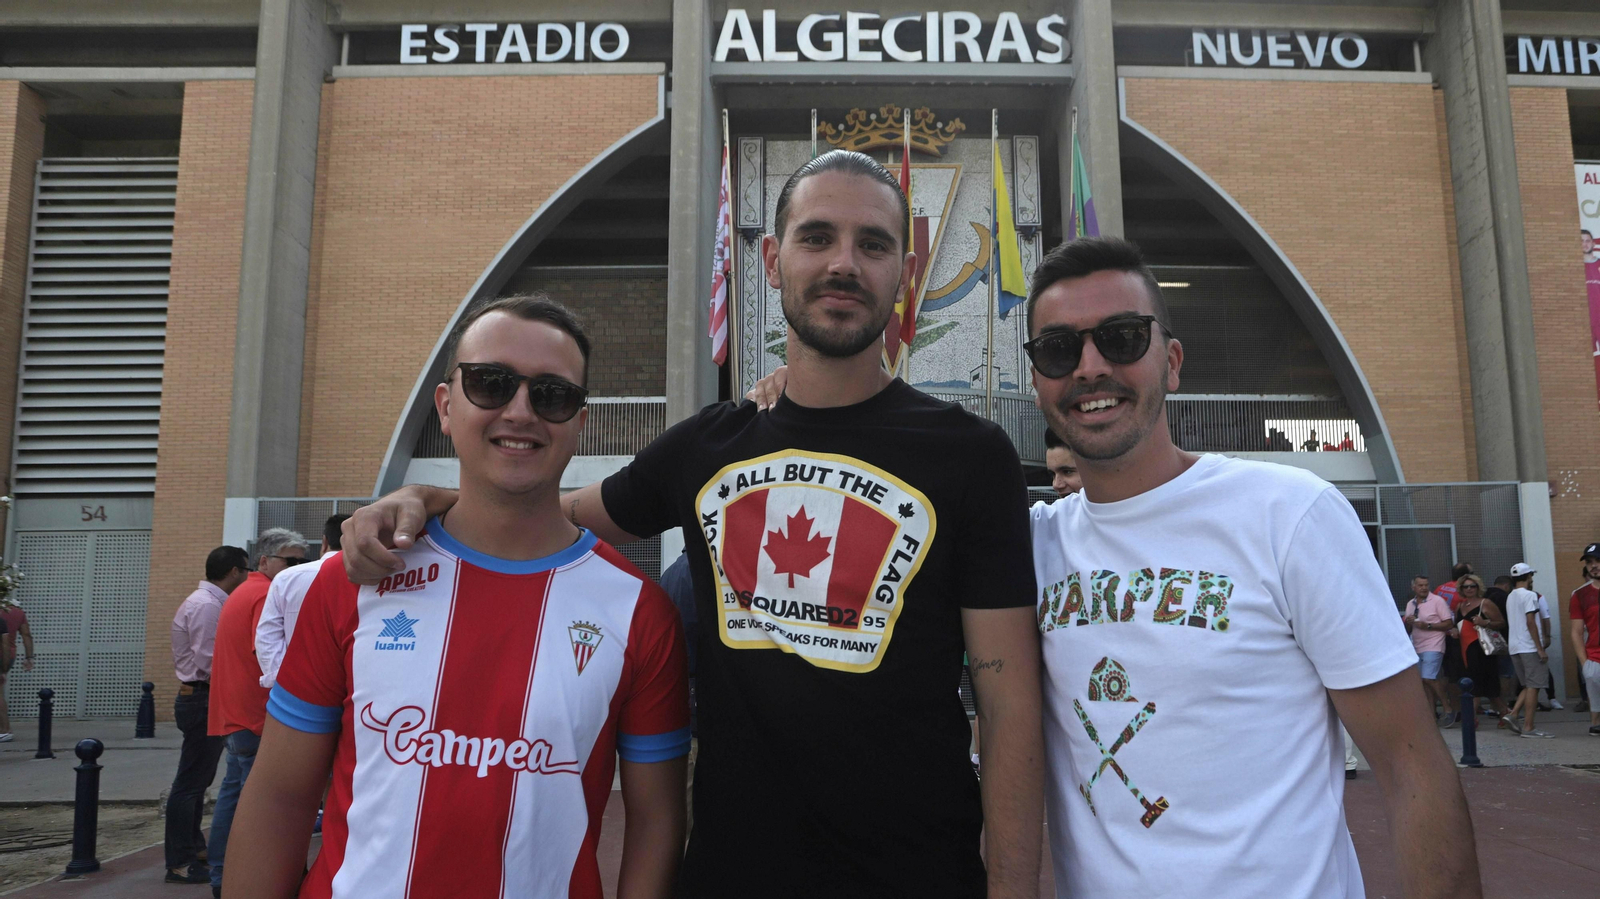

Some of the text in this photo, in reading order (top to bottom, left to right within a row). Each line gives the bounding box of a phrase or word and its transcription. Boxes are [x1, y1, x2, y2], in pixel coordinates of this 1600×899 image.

[400, 8, 1600, 75] ESTADIO ALGECIRAS NUEVO MIR
[81, 505, 108, 522] 54
[736, 466, 776, 492] ALL
[783, 463, 833, 484] BUT
[839, 470, 889, 505] THE
[875, 533, 920, 604] FLAG
[375, 562, 440, 597] APOLO
[724, 592, 736, 604] 19
[863, 616, 886, 628] 95
[1038, 567, 1234, 634] HARPER
[374, 640, 416, 651] luanvi
[727, 619, 746, 629] ONE
[812, 635, 839, 649] FOR
[840, 639, 878, 654] MANY
[360, 701, 581, 778] Campea
